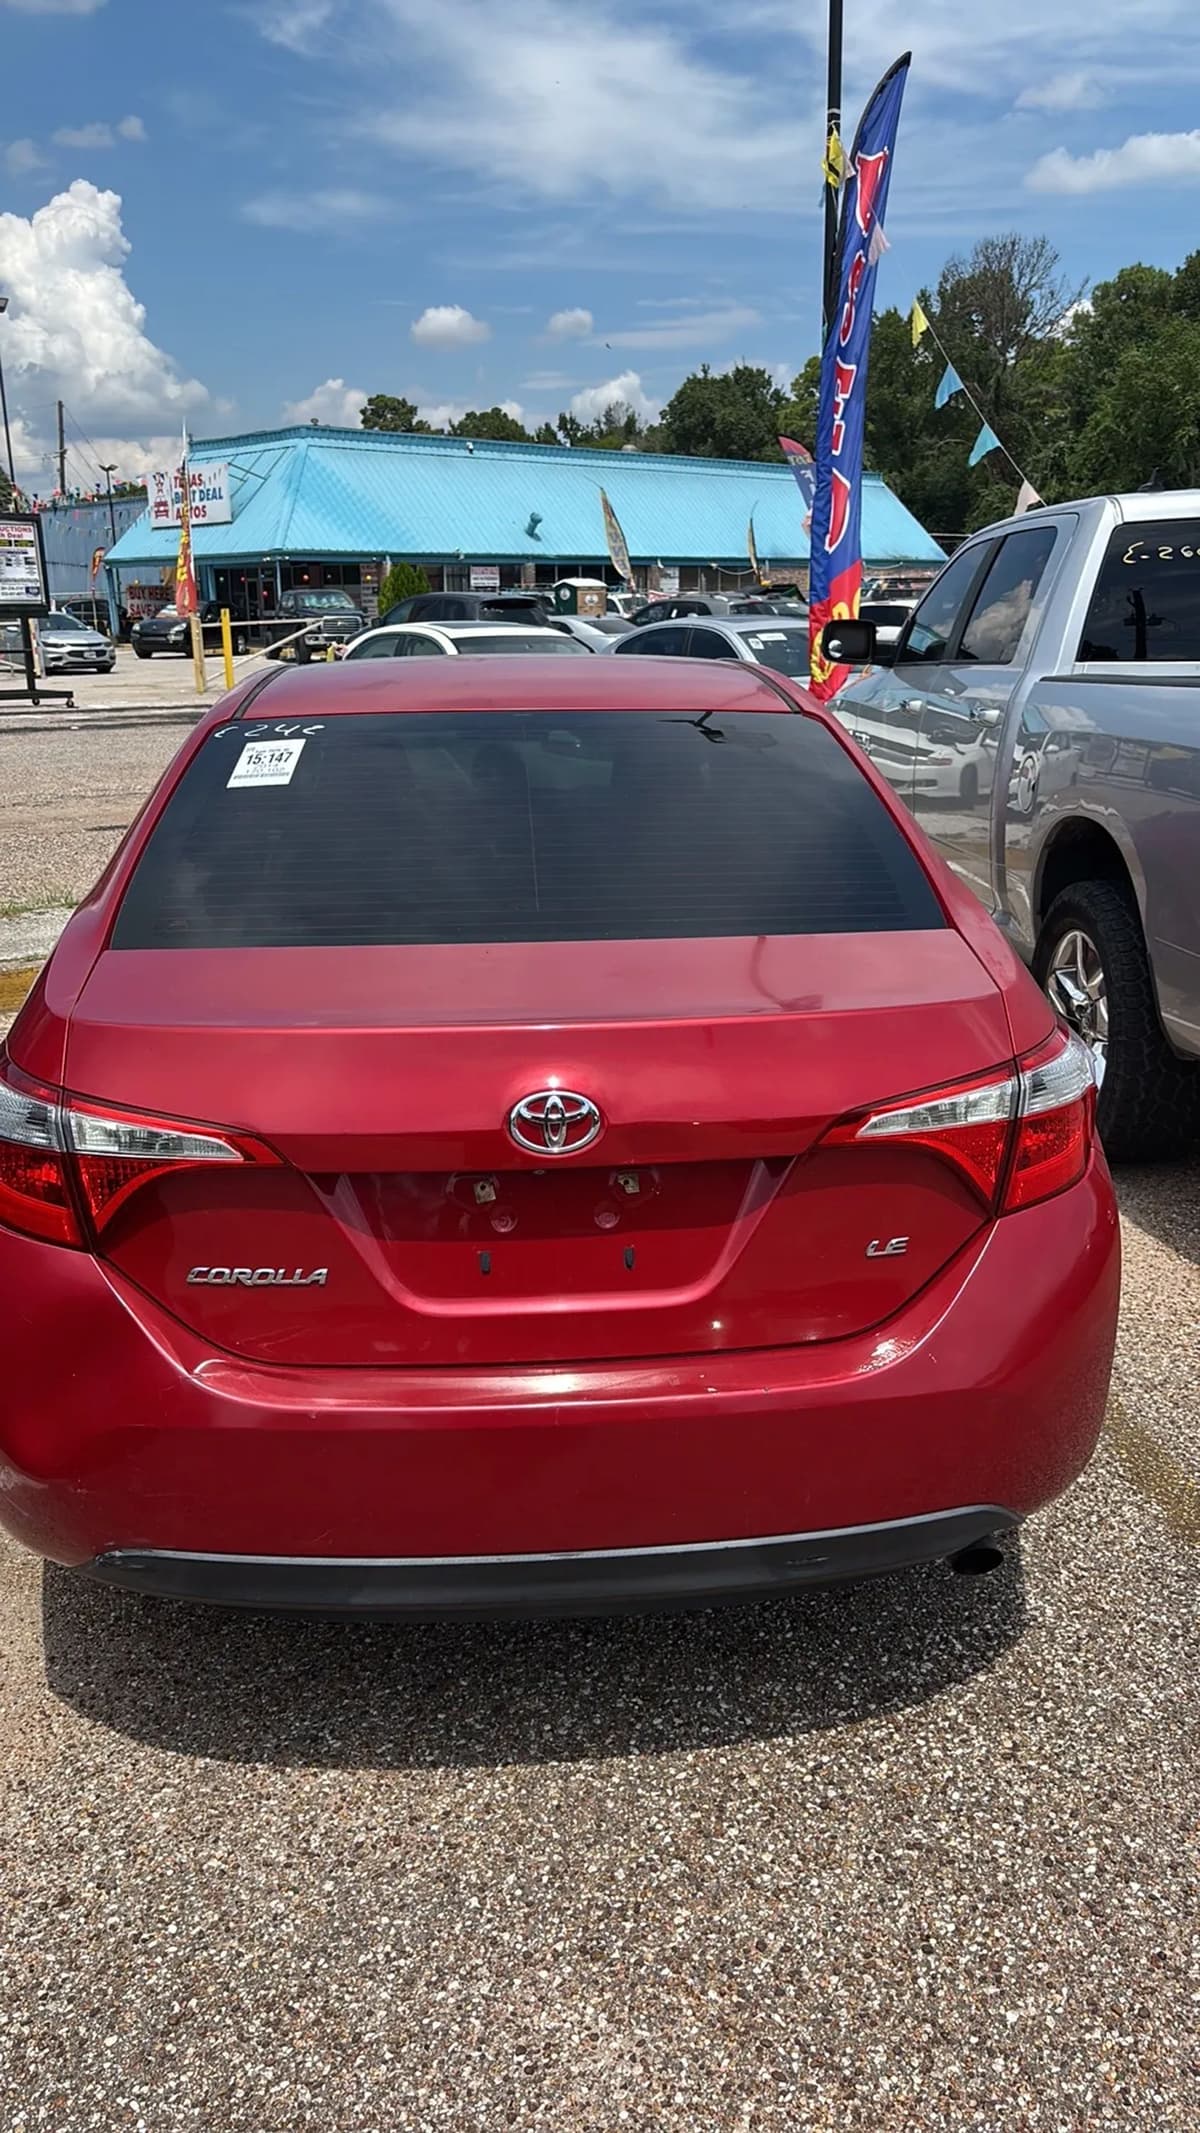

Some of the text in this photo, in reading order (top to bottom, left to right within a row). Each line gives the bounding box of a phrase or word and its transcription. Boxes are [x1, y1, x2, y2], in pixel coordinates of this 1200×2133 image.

[199, 487, 224, 502] DEAL
[246, 751, 294, 765] 15:147
[866, 1236, 910, 1257] LE
[186, 1266, 329, 1286] COROLLA
